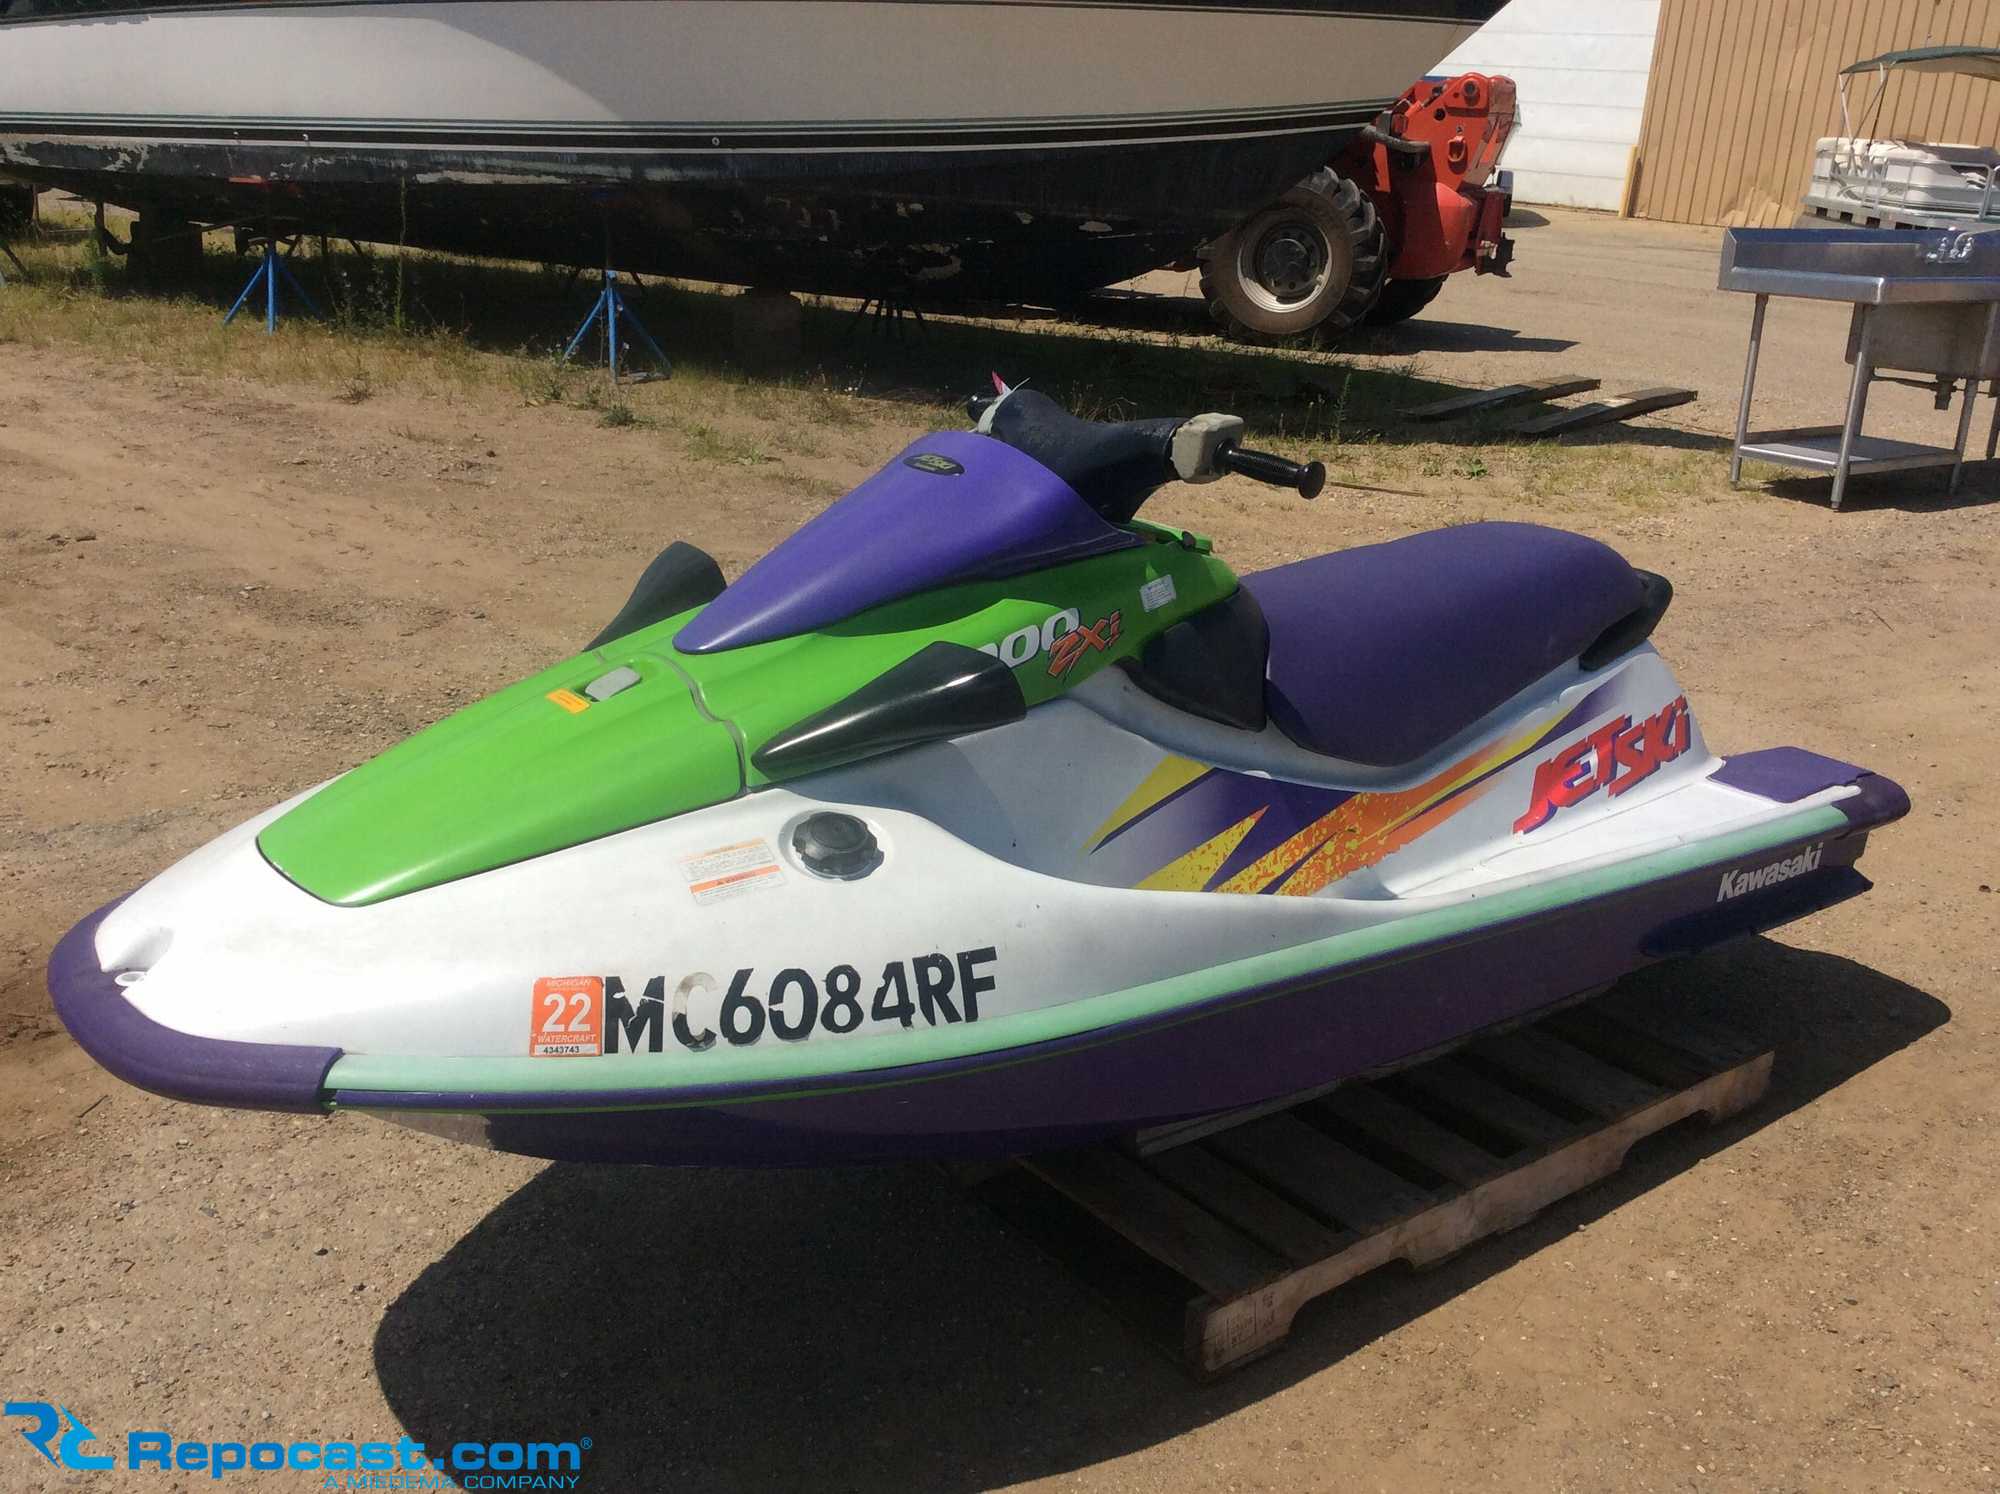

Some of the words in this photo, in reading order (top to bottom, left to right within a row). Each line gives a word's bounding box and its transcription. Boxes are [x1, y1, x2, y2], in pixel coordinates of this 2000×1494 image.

[1717, 843, 1824, 903] Kawasaki
[542, 992, 592, 1032] 22
[537, 1033, 597, 1044] WATERCRAFT
[543, 1045, 580, 1055] 4343743
